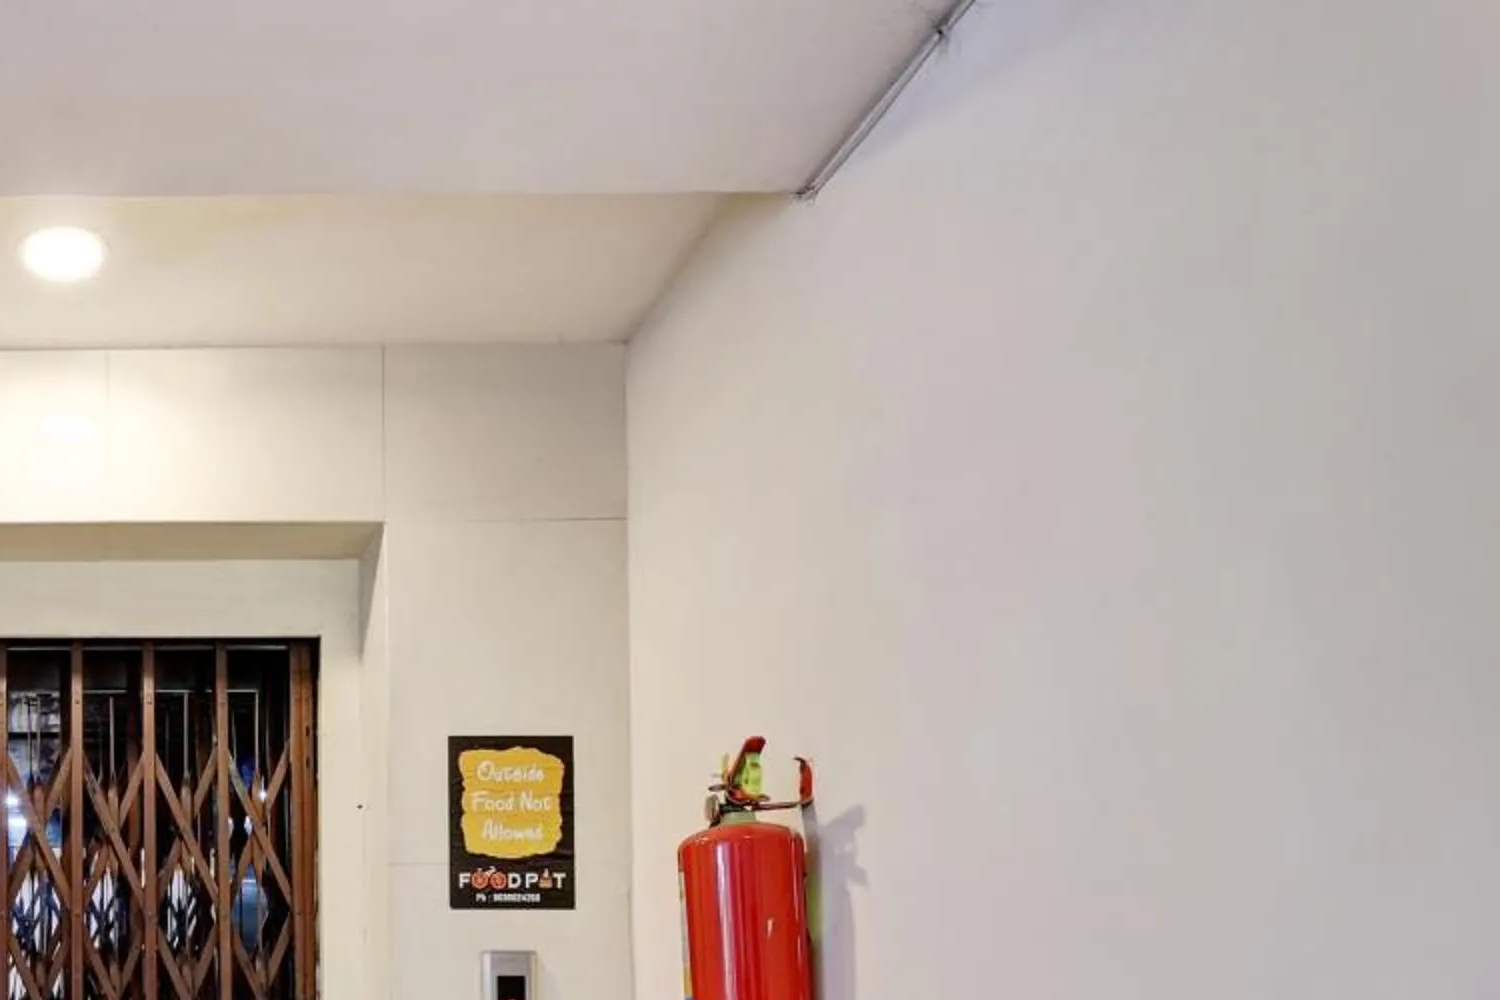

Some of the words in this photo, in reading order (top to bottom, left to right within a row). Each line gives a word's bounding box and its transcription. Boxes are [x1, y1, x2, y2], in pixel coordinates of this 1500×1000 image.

[476, 760, 545, 783] Outside
[471, 790, 515, 813] Food
[520, 789, 552, 812] Not
[482, 819, 544, 842] Allowed
